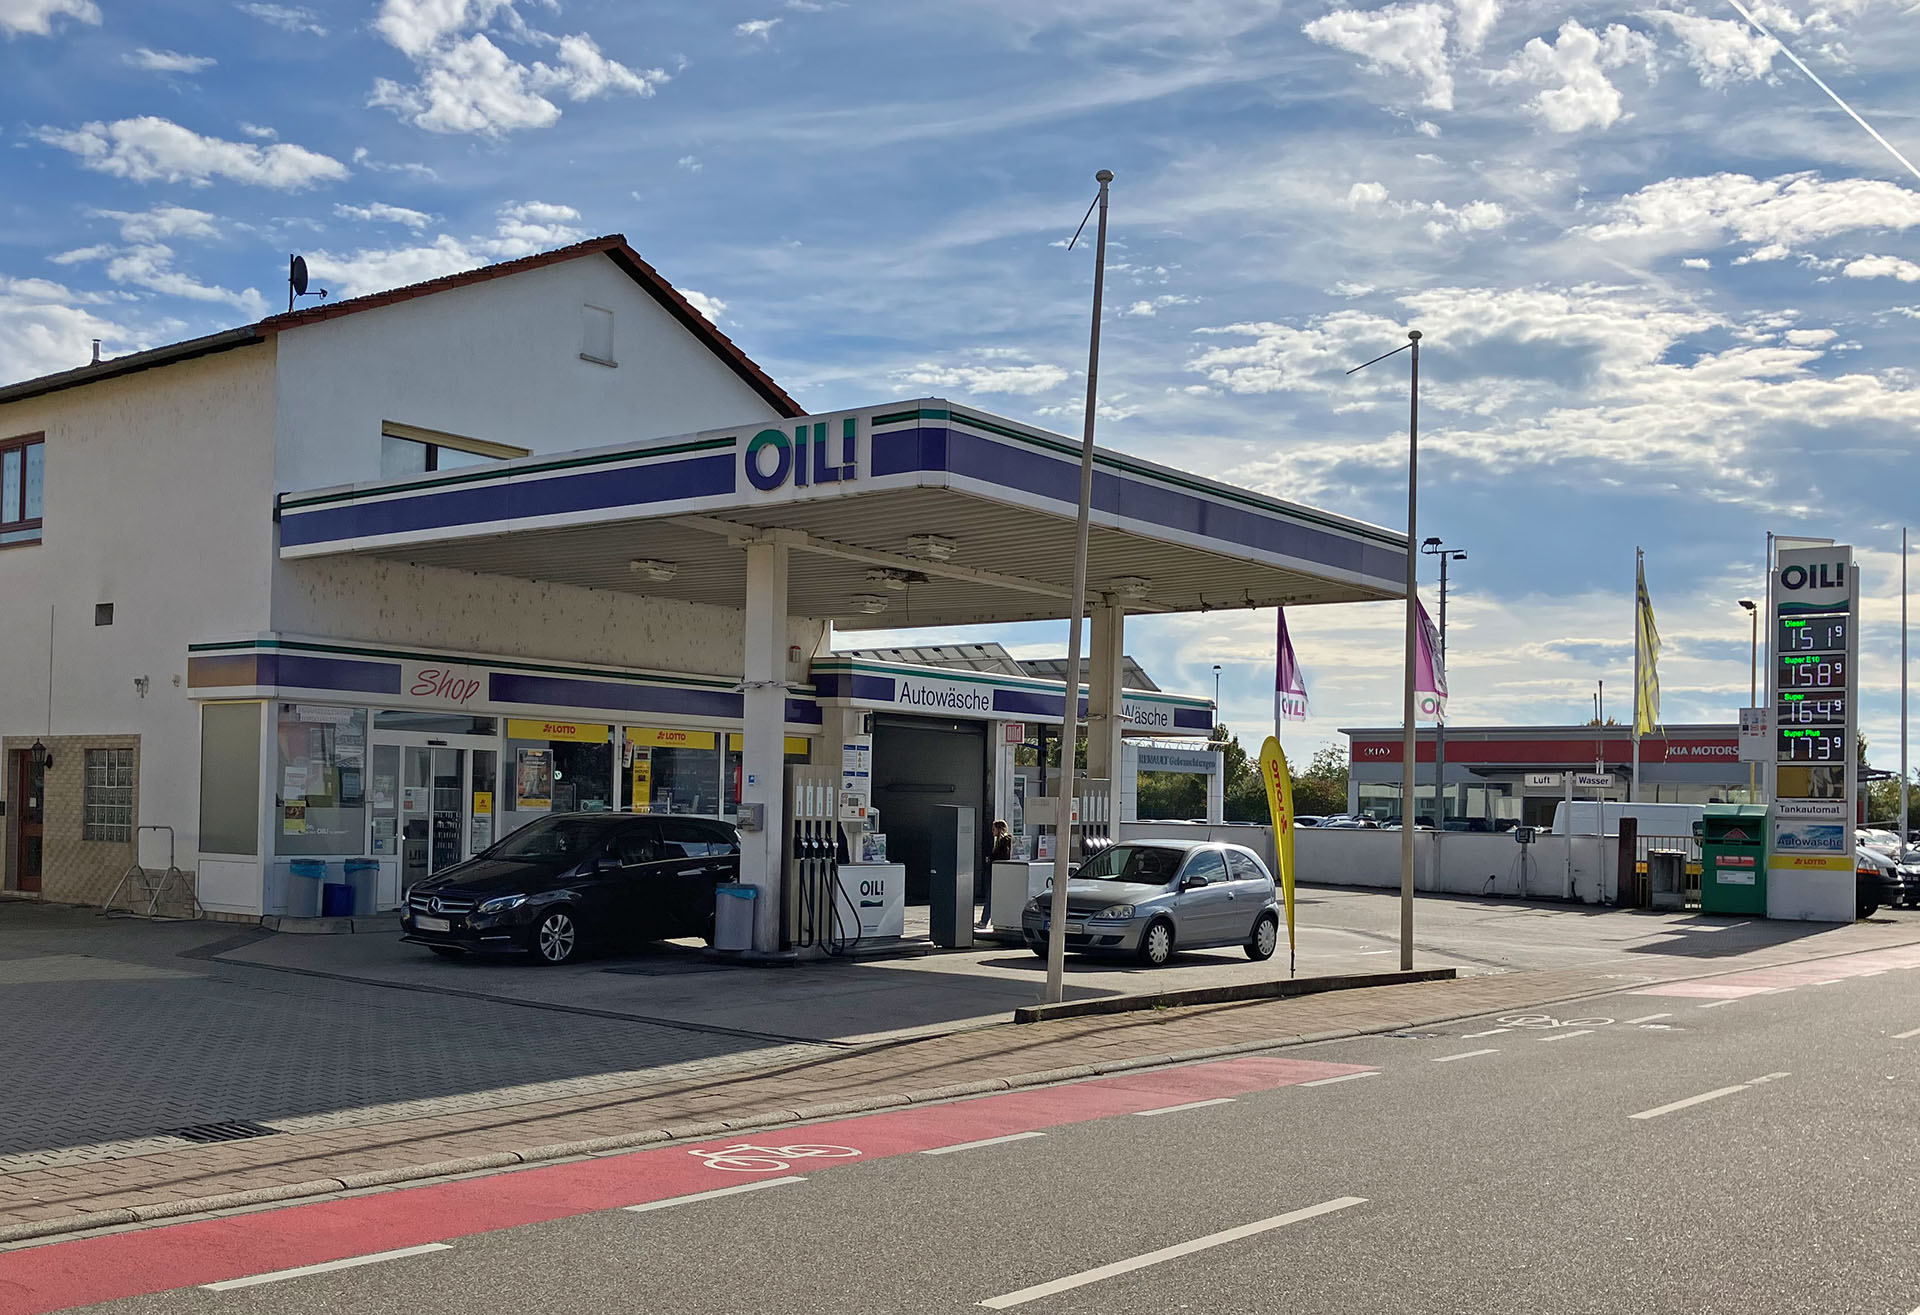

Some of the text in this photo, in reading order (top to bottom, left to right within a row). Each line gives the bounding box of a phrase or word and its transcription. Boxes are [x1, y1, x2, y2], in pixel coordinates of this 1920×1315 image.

[744, 417, 857, 492] OIL!
[1781, 563, 1844, 590] OIL!
[1784, 657, 1805, 665] Super
[410, 669, 480, 705] Shop
[900, 681, 989, 711] Autowäsche
[1784, 693, 1804, 701] Super
[552, 725, 576, 734] LOTTO
[1007, 726, 1021, 741] Bild
[1784, 730, 1804, 738] Super
[665, 732, 686, 741] LOTTO
[1669, 746, 1739, 756] KIA MOTORS
[1533, 776, 1550, 784] Luft
[1578, 776, 1608, 785] Wasser
[1272, 760, 1284, 811] LOTTO
[1780, 805, 1840, 814] Tankautomat
[1804, 858, 1827, 866] LOTTO
[860, 880, 884, 896] OIL!
